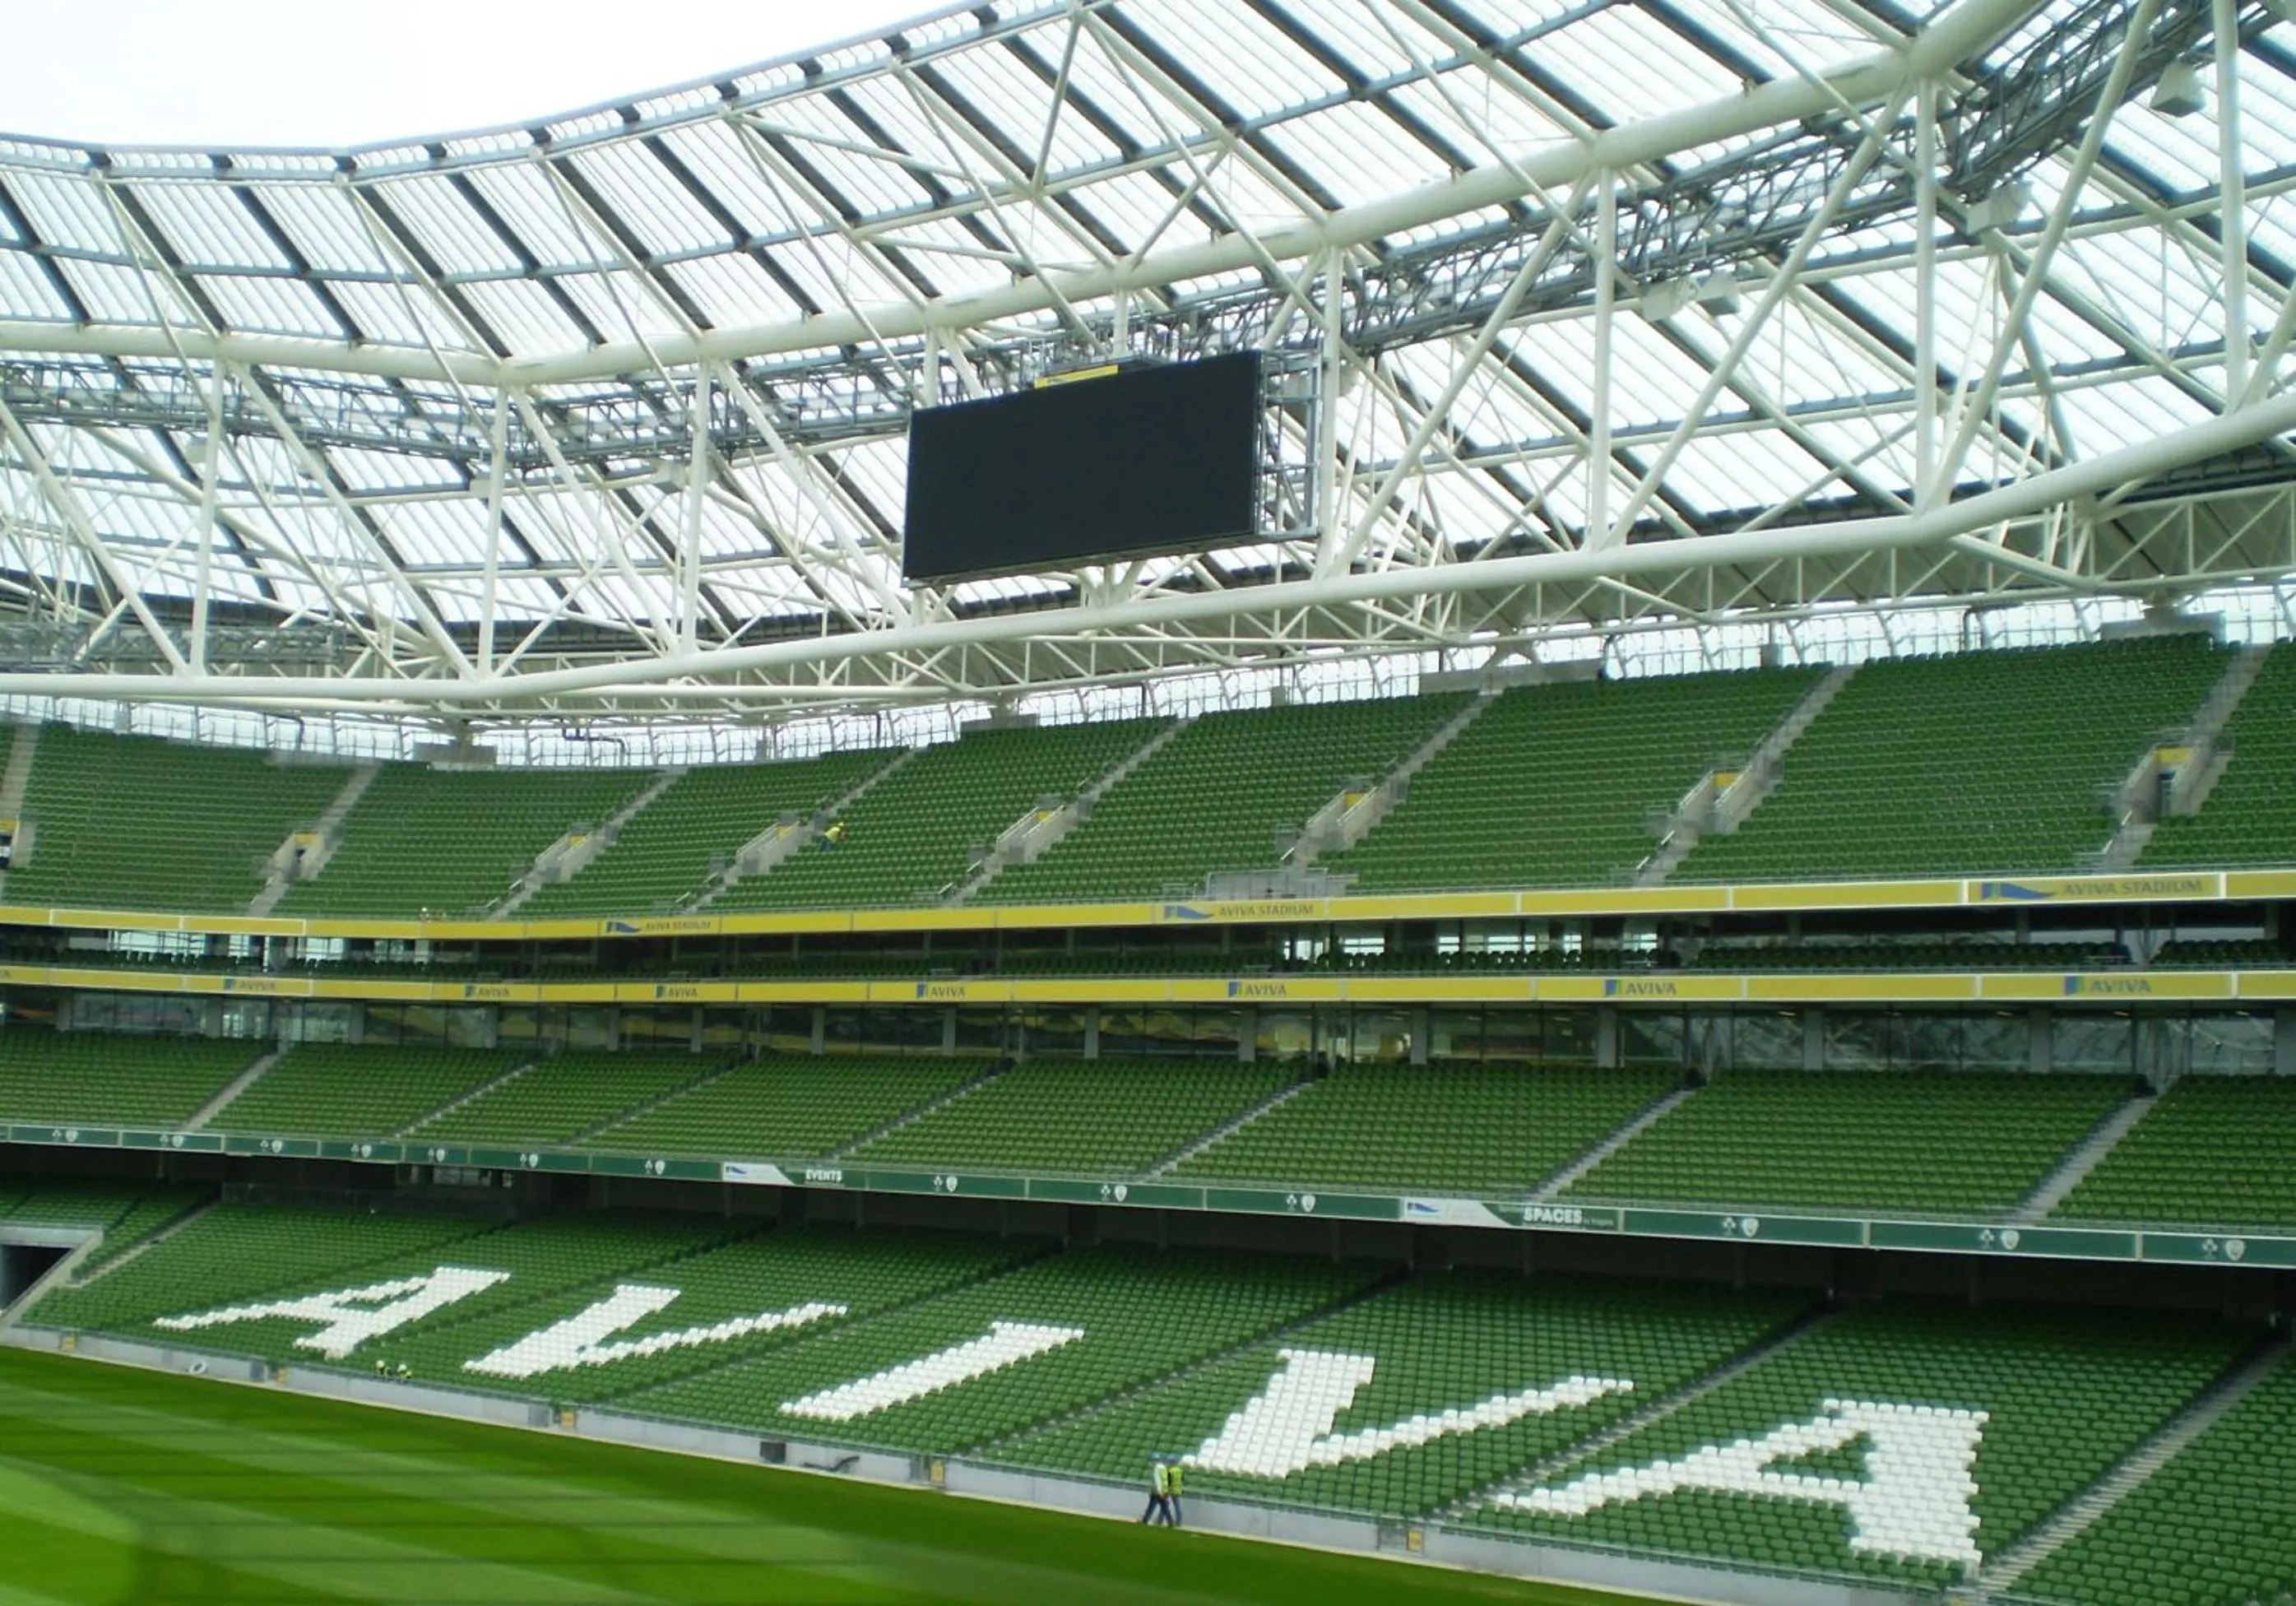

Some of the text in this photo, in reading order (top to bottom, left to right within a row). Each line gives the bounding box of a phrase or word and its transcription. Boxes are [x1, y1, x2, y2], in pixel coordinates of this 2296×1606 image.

[2063, 880, 2203, 896] AVIVA STADIUM
[1220, 904, 1314, 917] AVIVA STADIUM
[930, 986, 966, 999] AVIVA
[1245, 984, 1287, 997] AVIVA
[1626, 982, 1677, 996] AVIVA
[2090, 979, 2153, 994] AVIVA
[805, 1169, 842, 1182] EVENTS
[1524, 1206, 1584, 1225] SPACES
